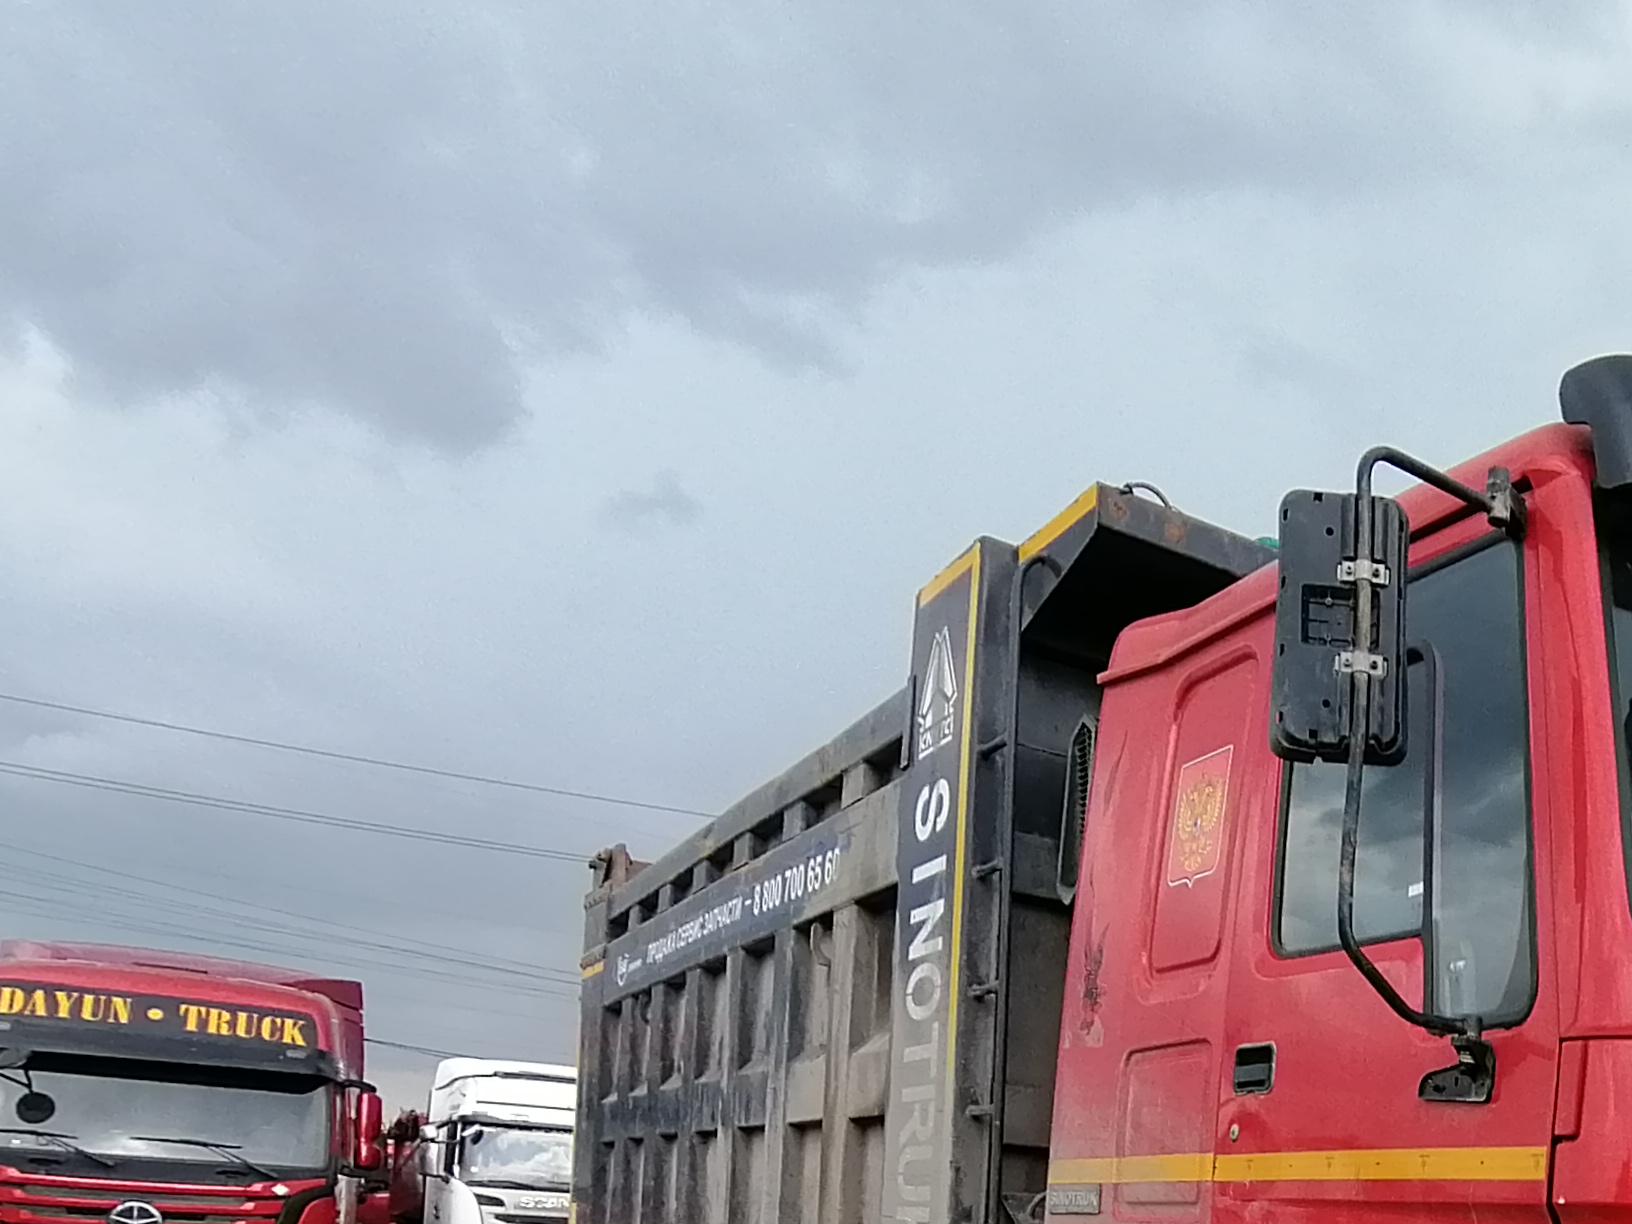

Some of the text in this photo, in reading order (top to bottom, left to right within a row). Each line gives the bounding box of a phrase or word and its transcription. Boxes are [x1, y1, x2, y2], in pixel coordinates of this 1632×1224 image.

[753, 885, 761, 916] 8
[762, 874, 782, 912] 800
[784, 864, 805, 902] 700
[806, 855, 823, 893] 65
[825, 848, 840, 885] 60
[0, 986, 308, 1047] DAYUN TRUCK
